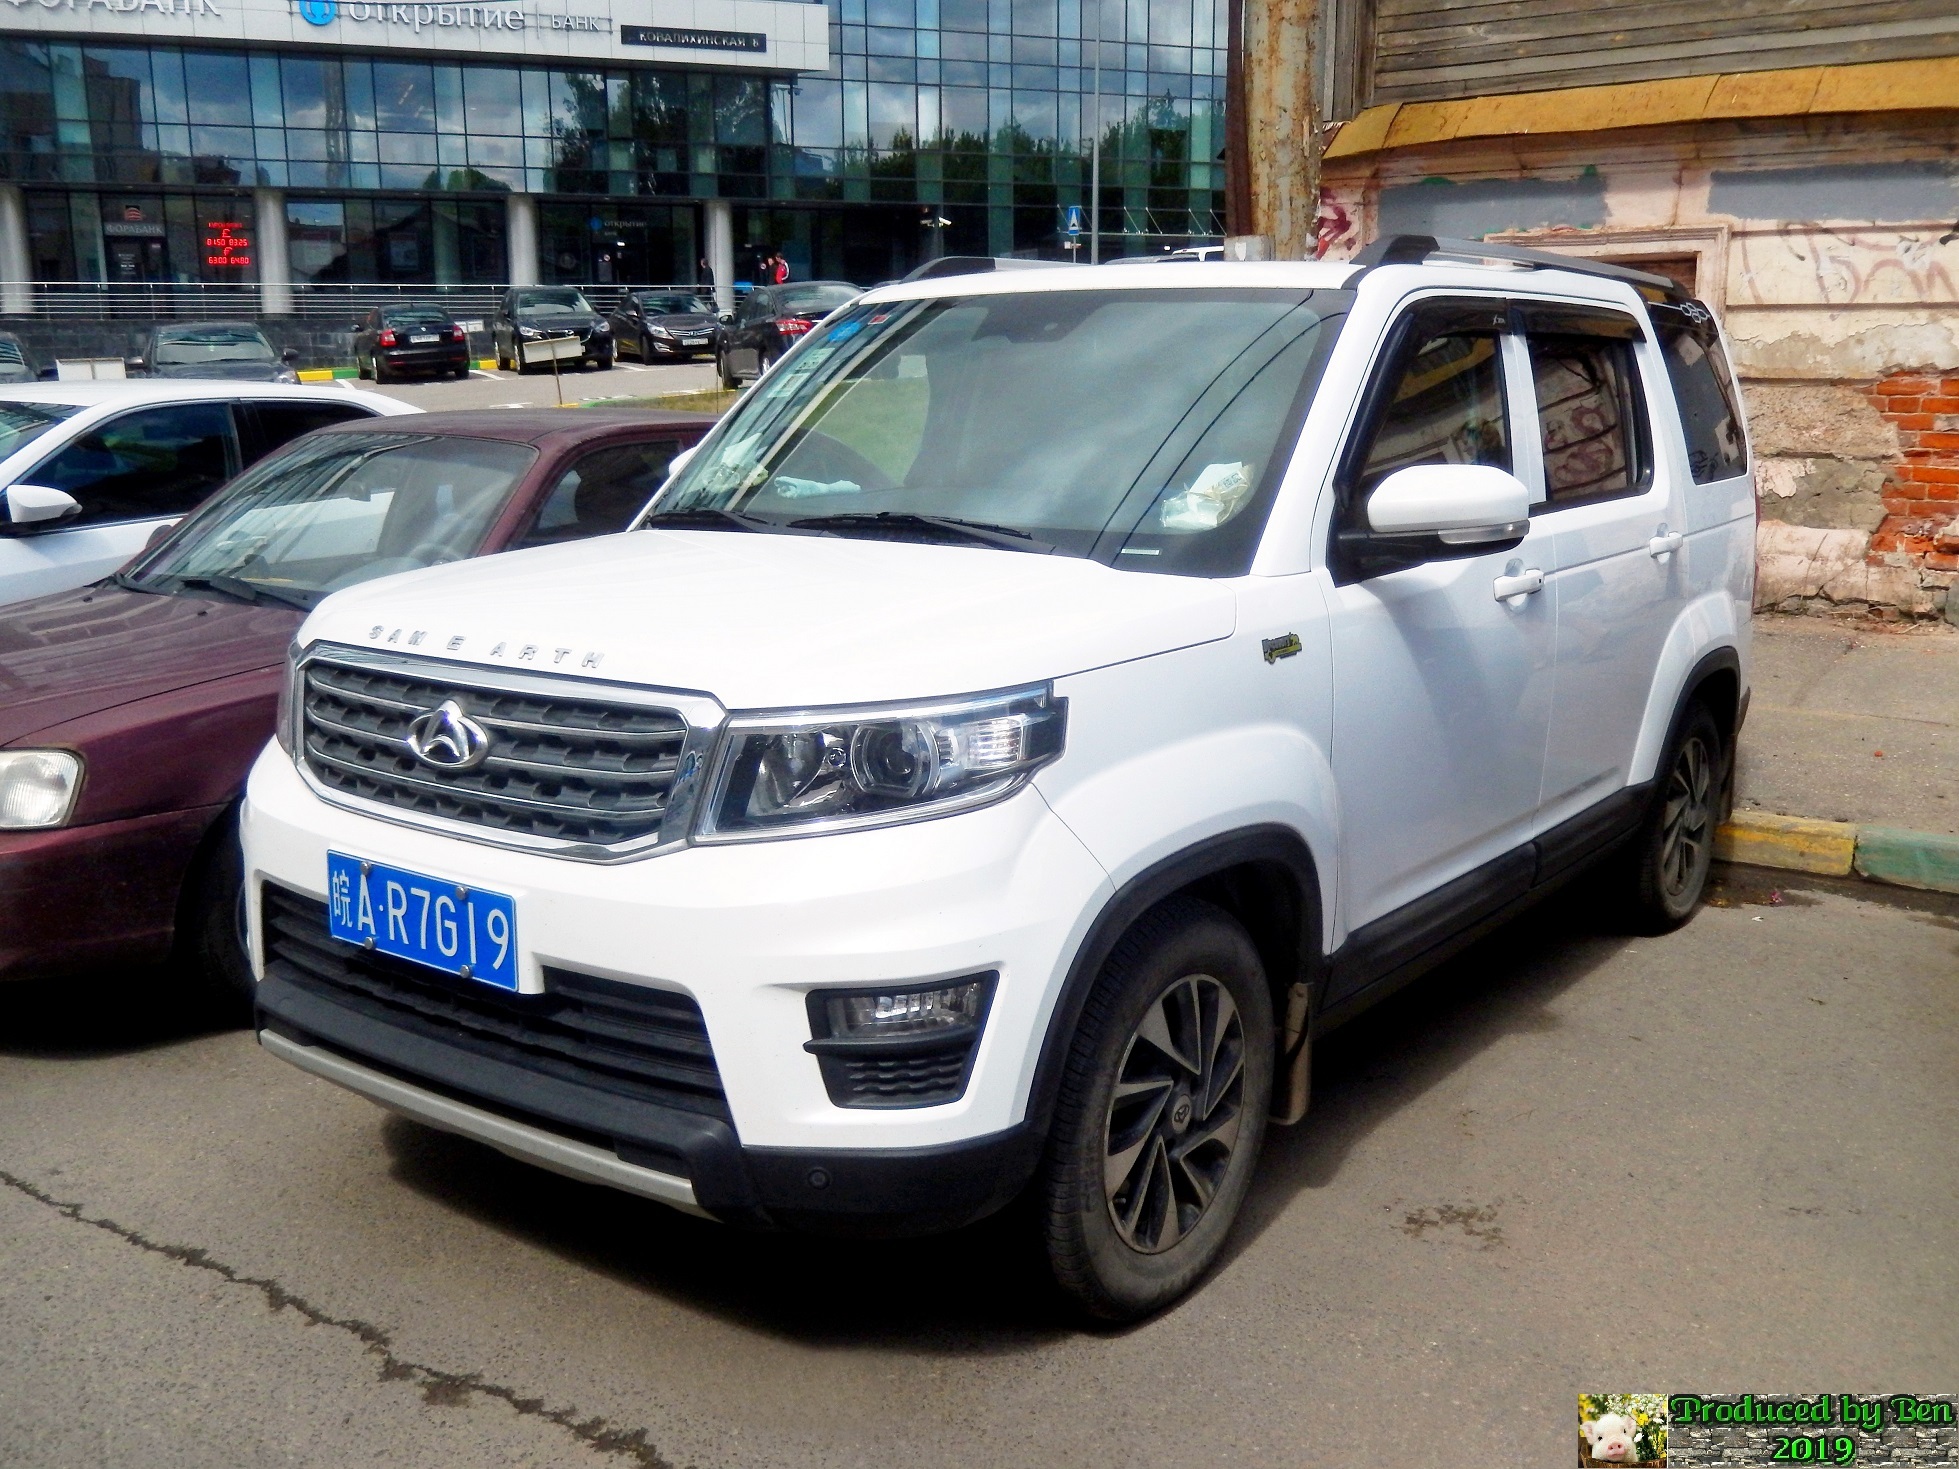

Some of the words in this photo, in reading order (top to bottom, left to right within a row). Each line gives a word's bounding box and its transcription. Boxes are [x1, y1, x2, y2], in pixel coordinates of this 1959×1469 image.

[350, 4, 525, 33] открытие
[551, 14, 600, 30] БАНК
[639, 31, 746, 47] КОВАЛИХИНСКАЯ
[106, 223, 163, 234] ФОРАБАНК
